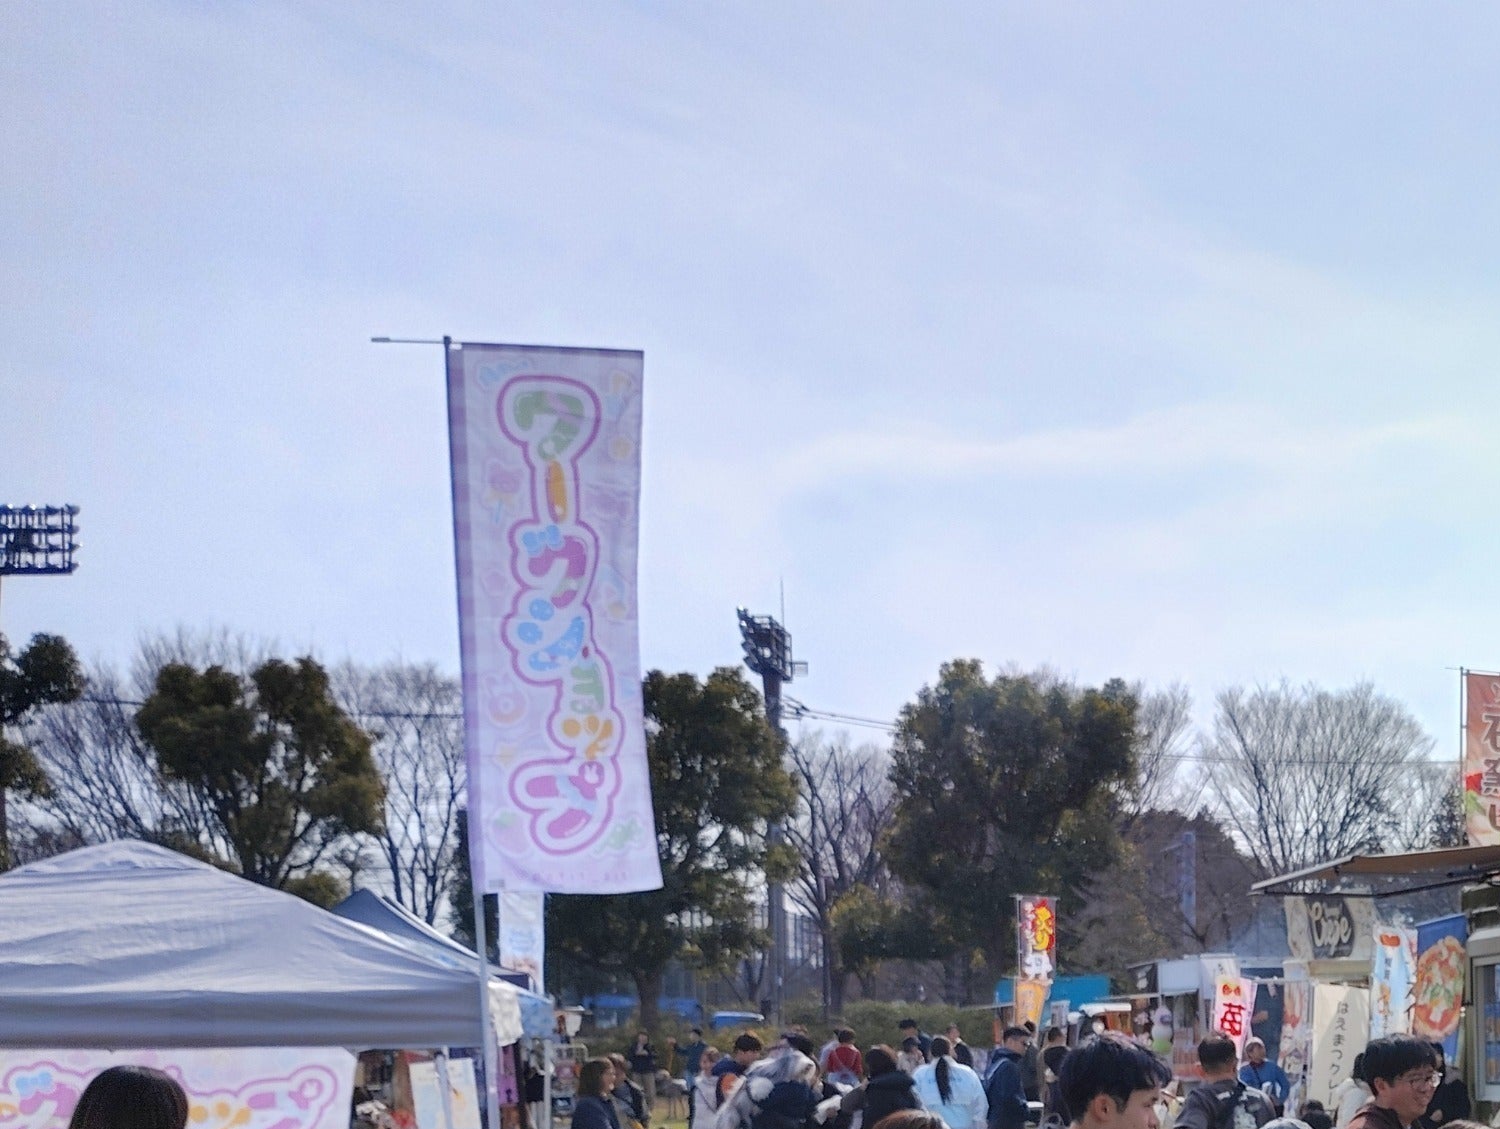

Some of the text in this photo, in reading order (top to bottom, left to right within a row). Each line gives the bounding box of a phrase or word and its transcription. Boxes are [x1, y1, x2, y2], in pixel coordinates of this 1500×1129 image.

[1327, 1000, 1349, 1112] はえまつクレー
